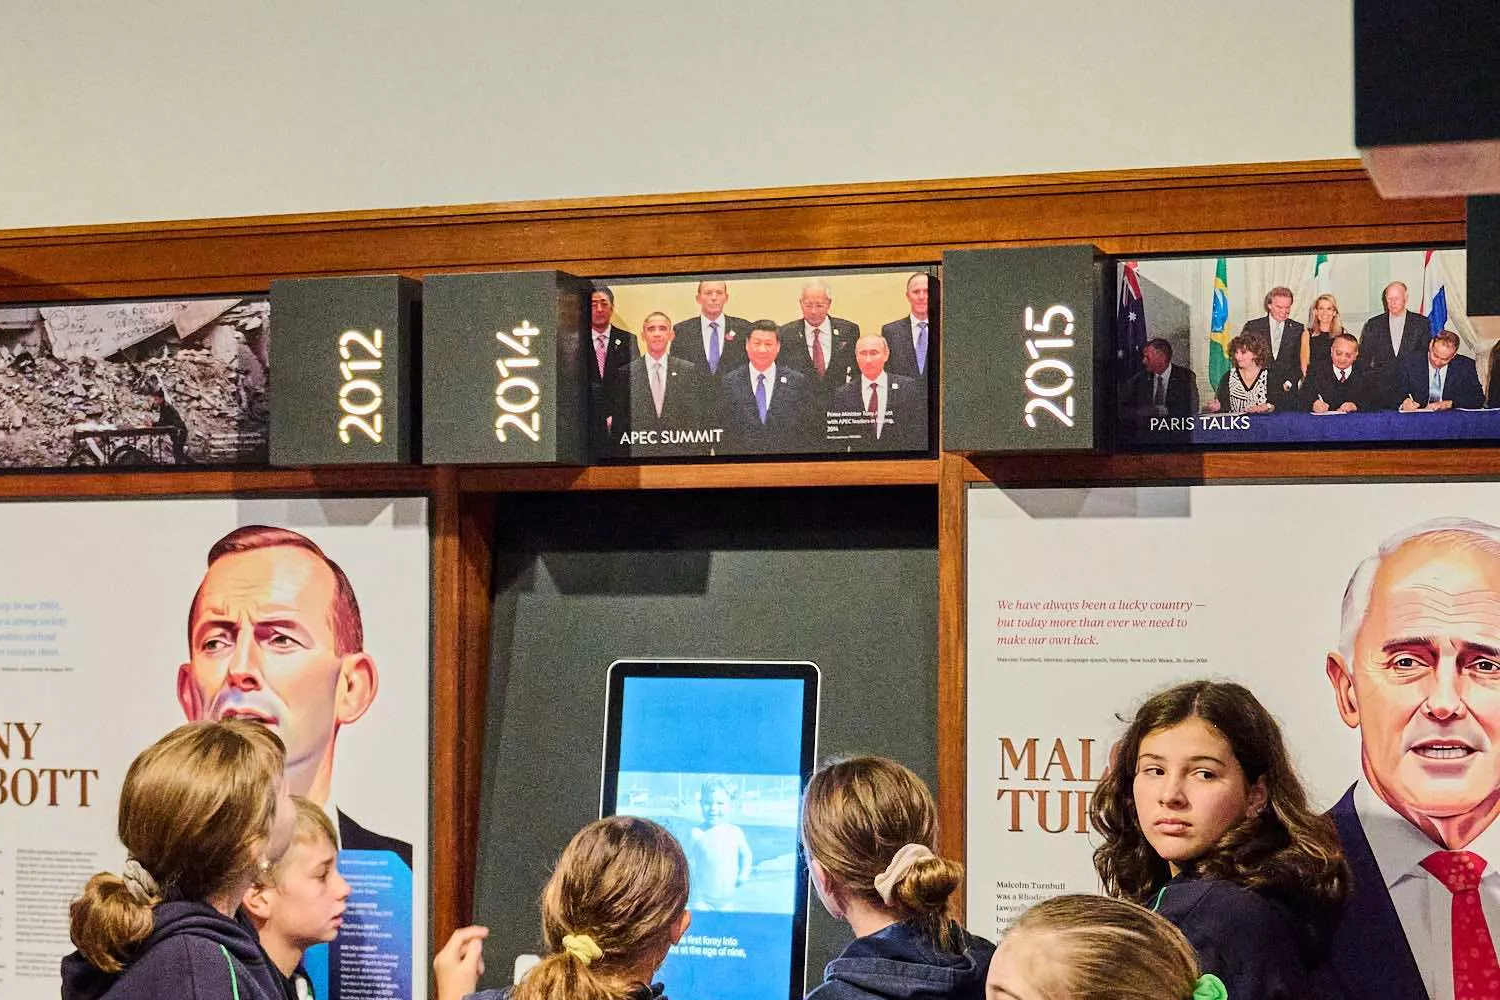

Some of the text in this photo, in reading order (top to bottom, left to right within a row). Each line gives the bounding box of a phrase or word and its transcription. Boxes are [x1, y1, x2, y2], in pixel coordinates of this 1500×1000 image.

[1024, 304, 1074, 428] 2015
[338, 329, 382, 444] 2012
[495, 320, 541, 443] 2014
[1150, 415, 1251, 431] PARIS TALKS
[620, 428, 723, 446] APEC SUMMIT
[997, 599, 1193, 613] We have always been a lucky country
[996, 617, 1188, 630] but today more than ever we need to
[996, 634, 1099, 646] make our own luck.
[996, 881, 1066, 890] Malcolm Turnbull
